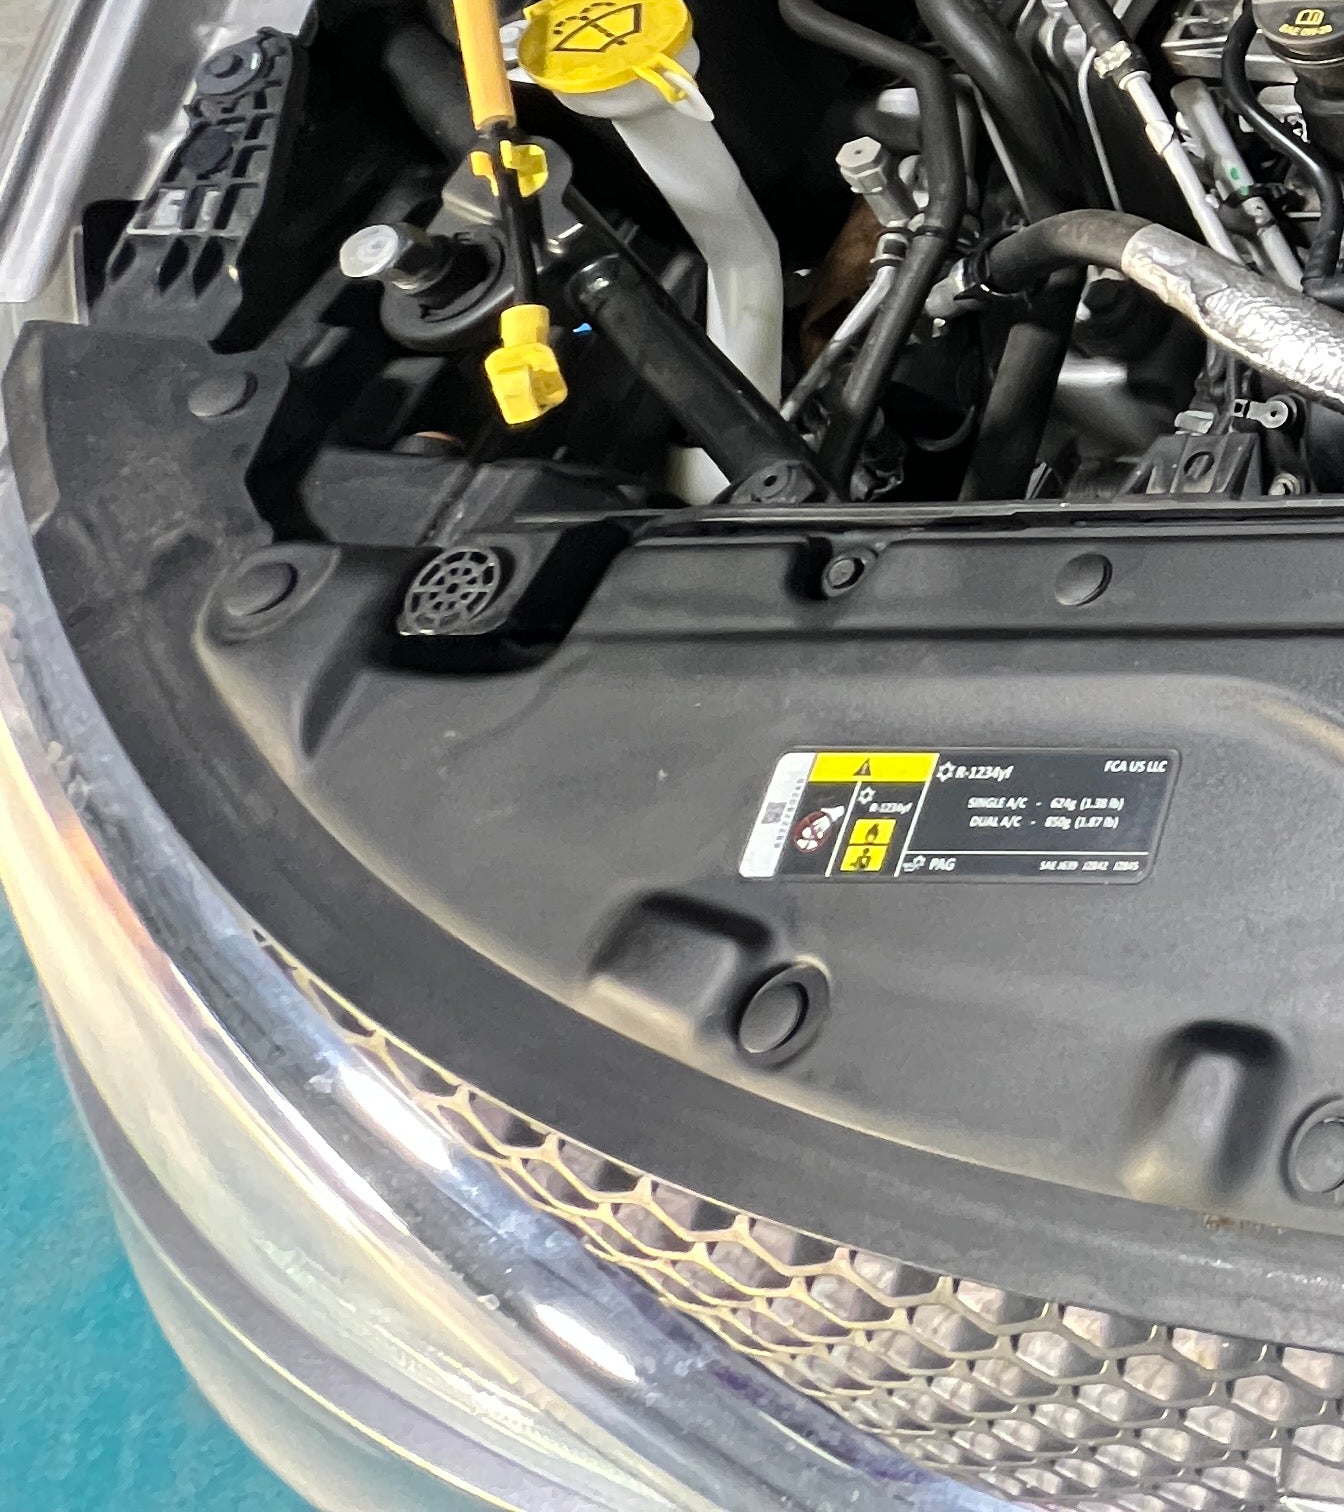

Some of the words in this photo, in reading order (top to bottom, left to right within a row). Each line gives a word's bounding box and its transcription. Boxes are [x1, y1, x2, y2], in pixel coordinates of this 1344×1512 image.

[955, 765, 1014, 781] R-1234yf
[1103, 761, 1128, 773] FCA
[1128, 761, 1147, 773] US
[1147, 761, 1169, 773] LLC
[967, 797, 1006, 809] SINGLE
[1005, 797, 1029, 810] A/C
[1050, 797, 1077, 811] 624g
[969, 816, 999, 828] DUAL
[998, 816, 1022, 829] A/C
[1044, 816, 1072, 830] 850g
[1074, 816, 1103, 829] (1.87
[929, 857, 956, 872] PAG
[1039, 861, 1056, 871] SAE
